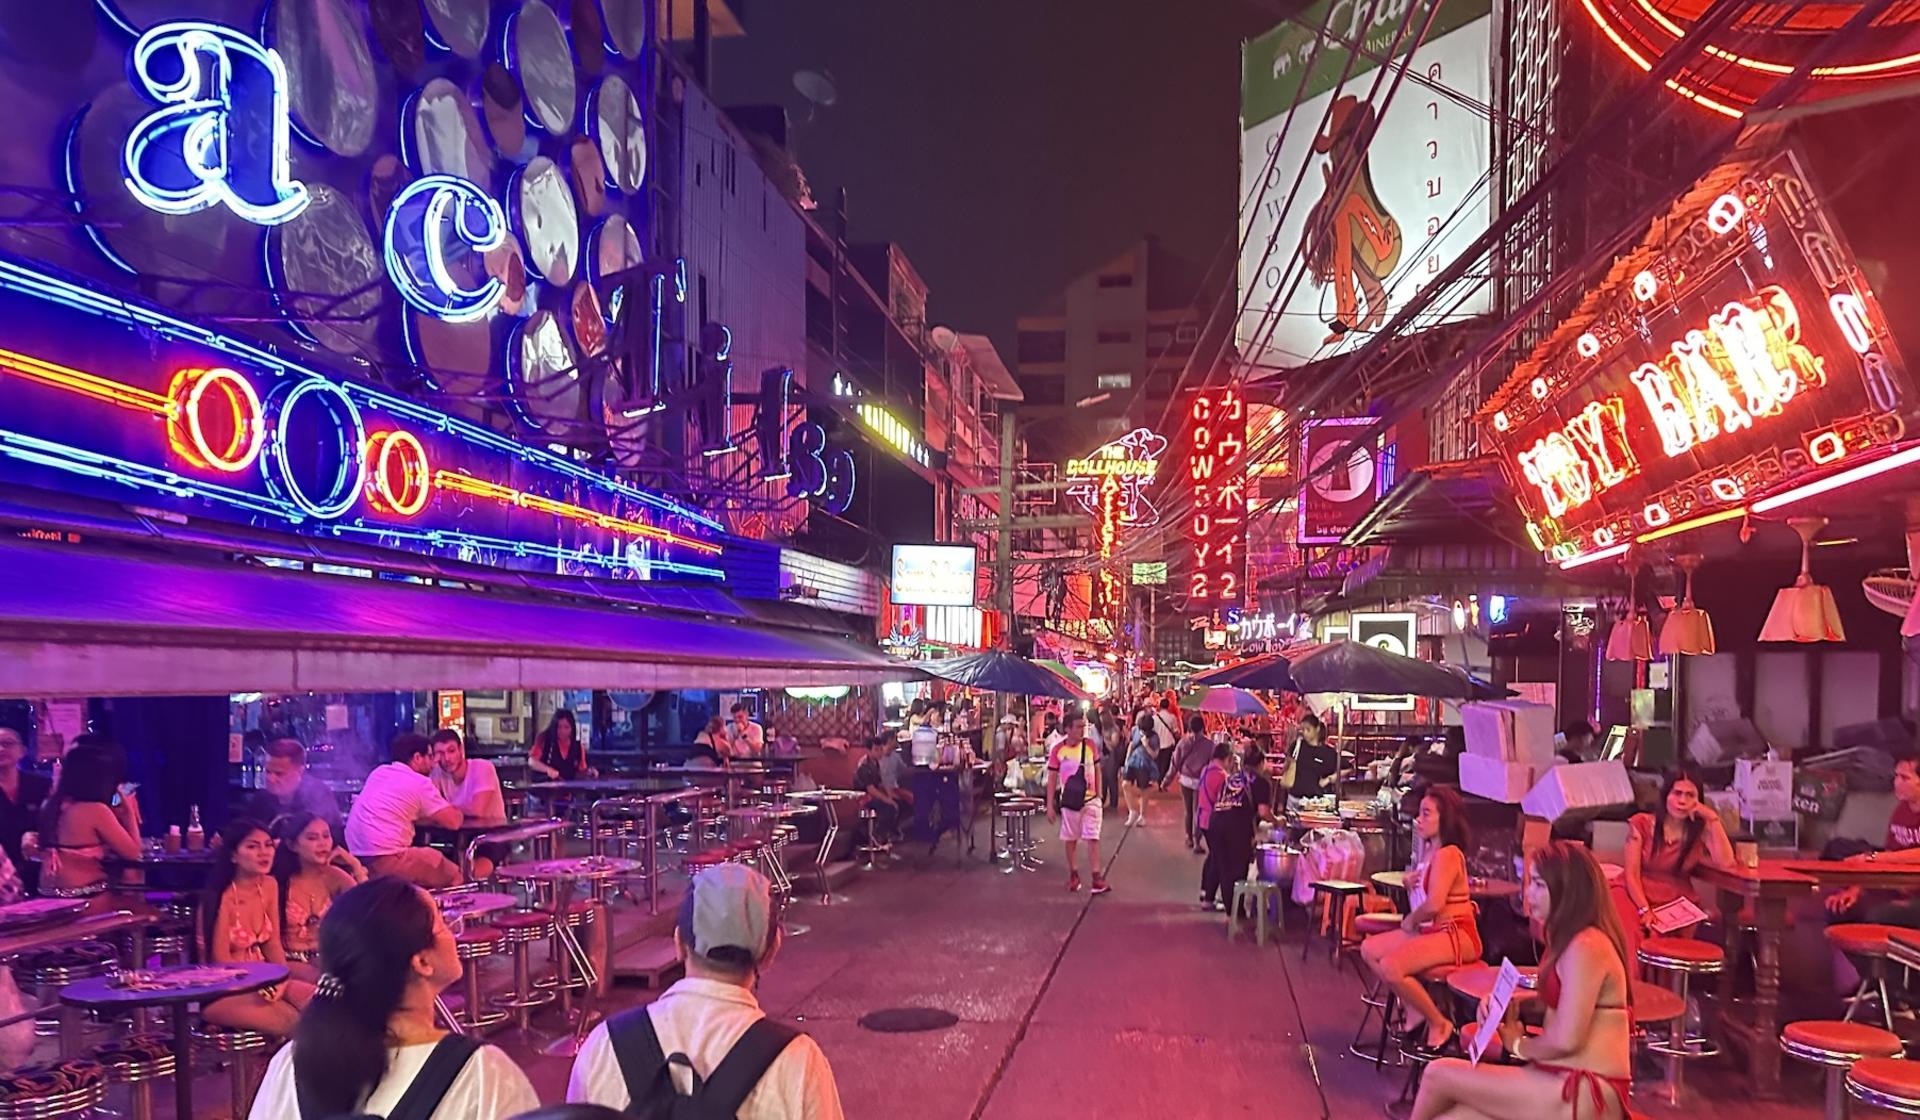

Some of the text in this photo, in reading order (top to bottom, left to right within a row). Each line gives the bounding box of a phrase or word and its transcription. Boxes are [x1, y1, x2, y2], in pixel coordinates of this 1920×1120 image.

[1628, 285, 1827, 458] BAR
[1102, 446, 1125, 460] THE
[1066, 459, 1158, 476] DOLLHOUSE
